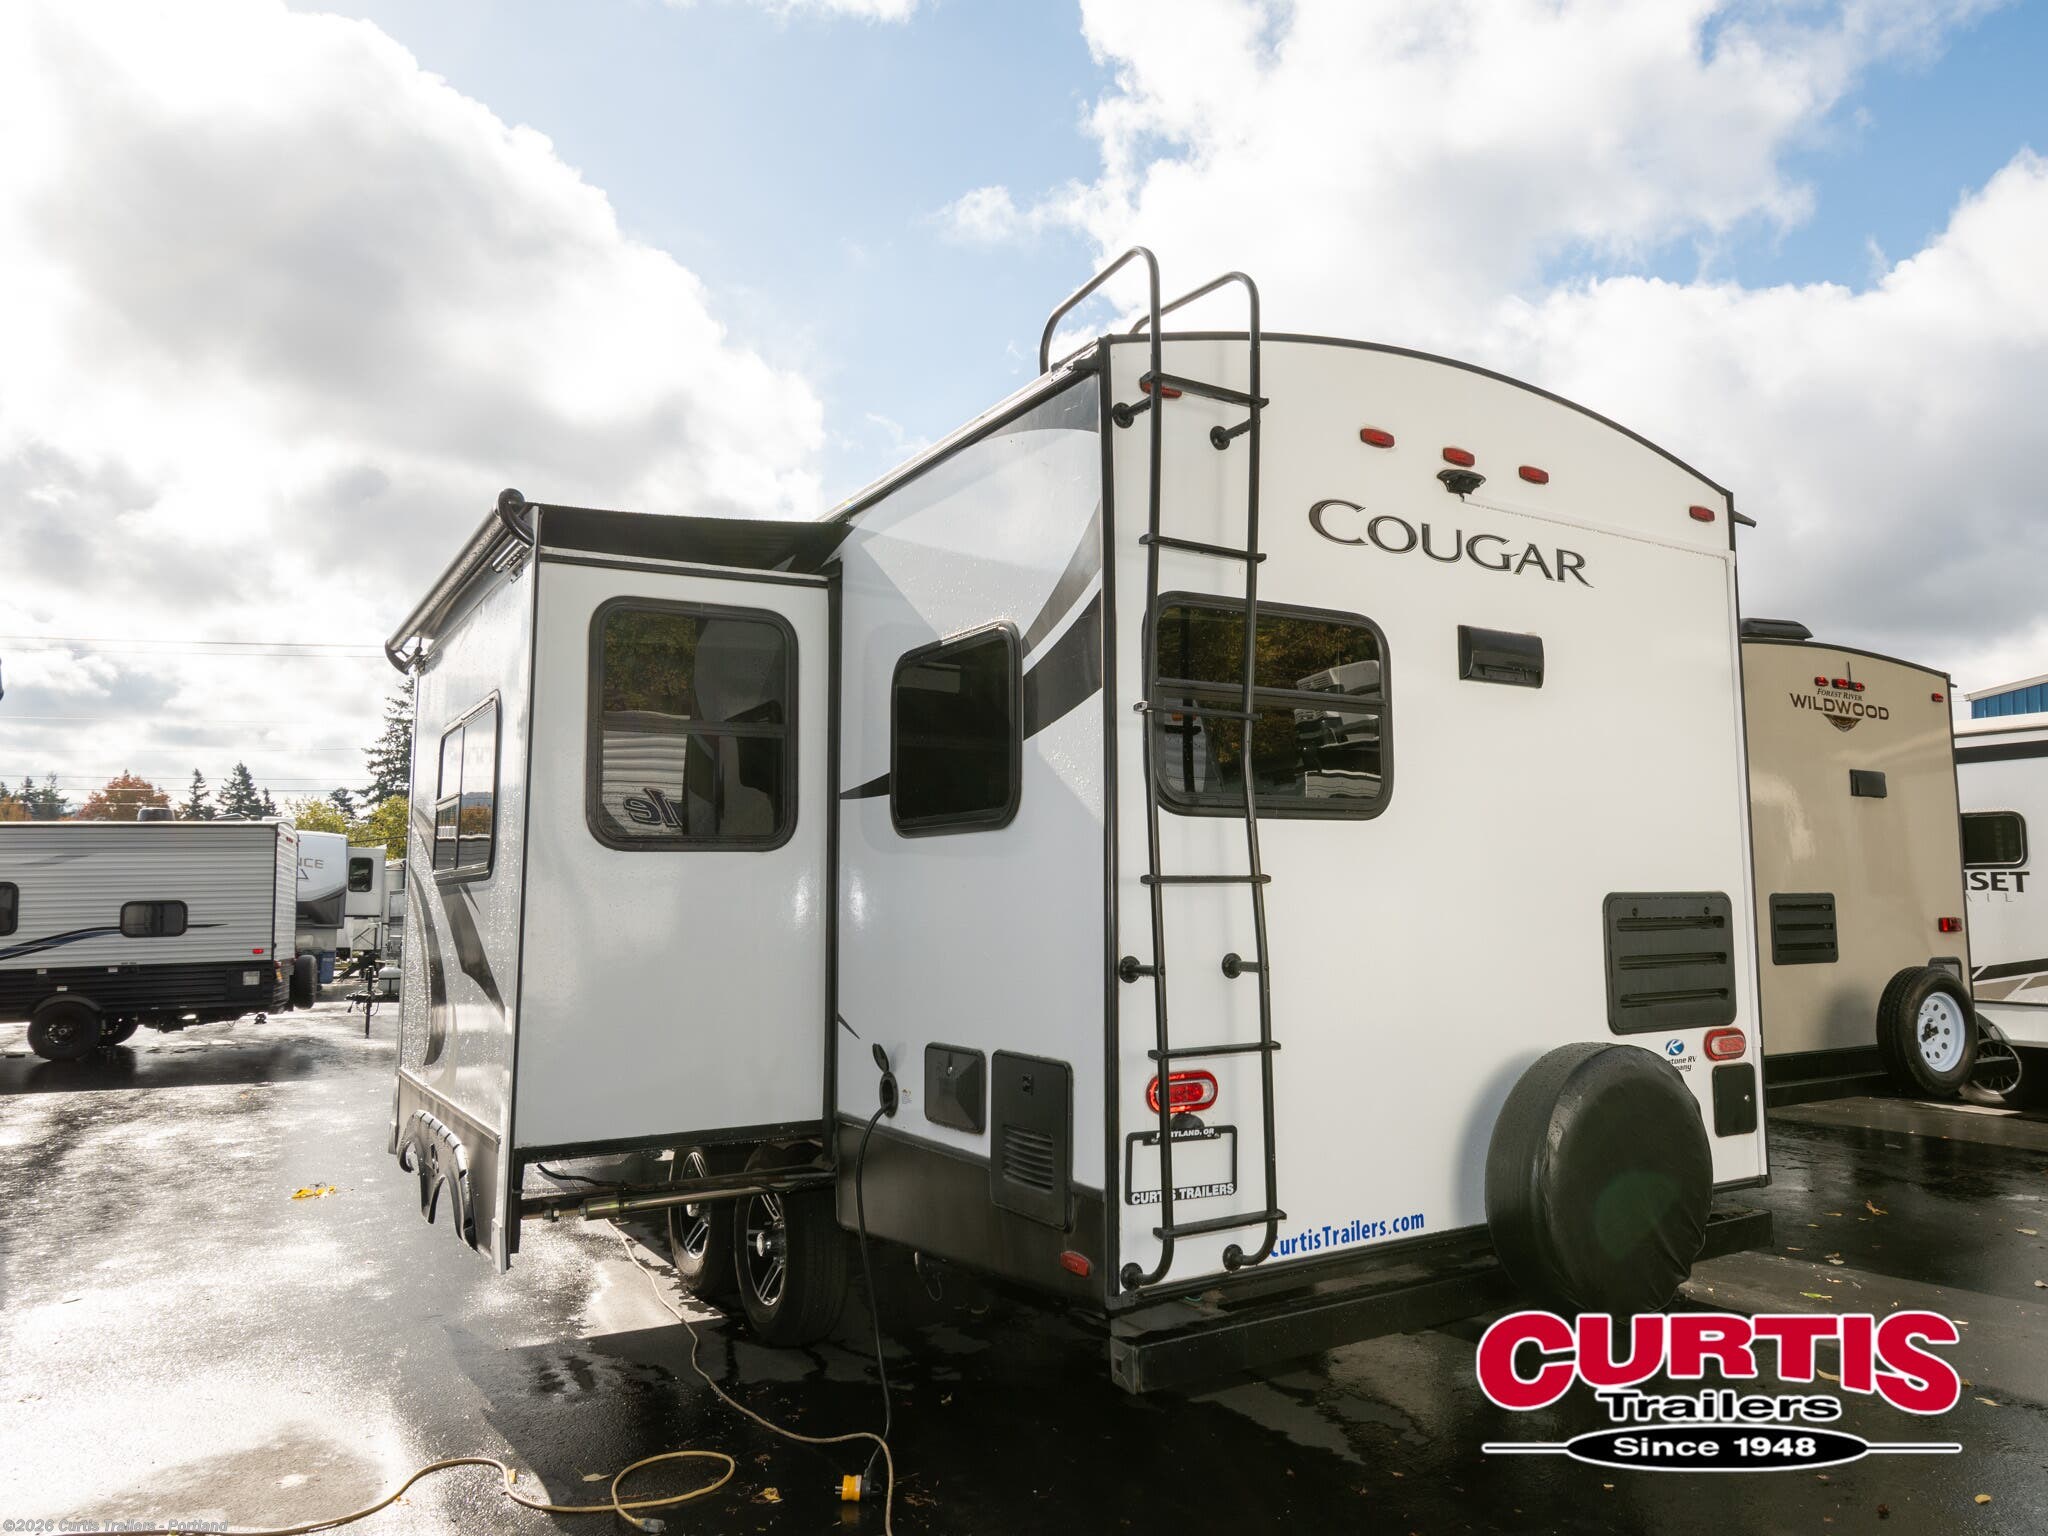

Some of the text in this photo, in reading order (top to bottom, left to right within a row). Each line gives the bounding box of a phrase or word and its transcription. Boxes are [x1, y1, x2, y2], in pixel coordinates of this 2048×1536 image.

[1308, 499, 1595, 588] COUGAR
[1790, 693, 1889, 720] WILDWOOD
[1817, 688, 1863, 701] FOREST RIVER
[1131, 1183, 1234, 1205] CURTS TRAILERS
